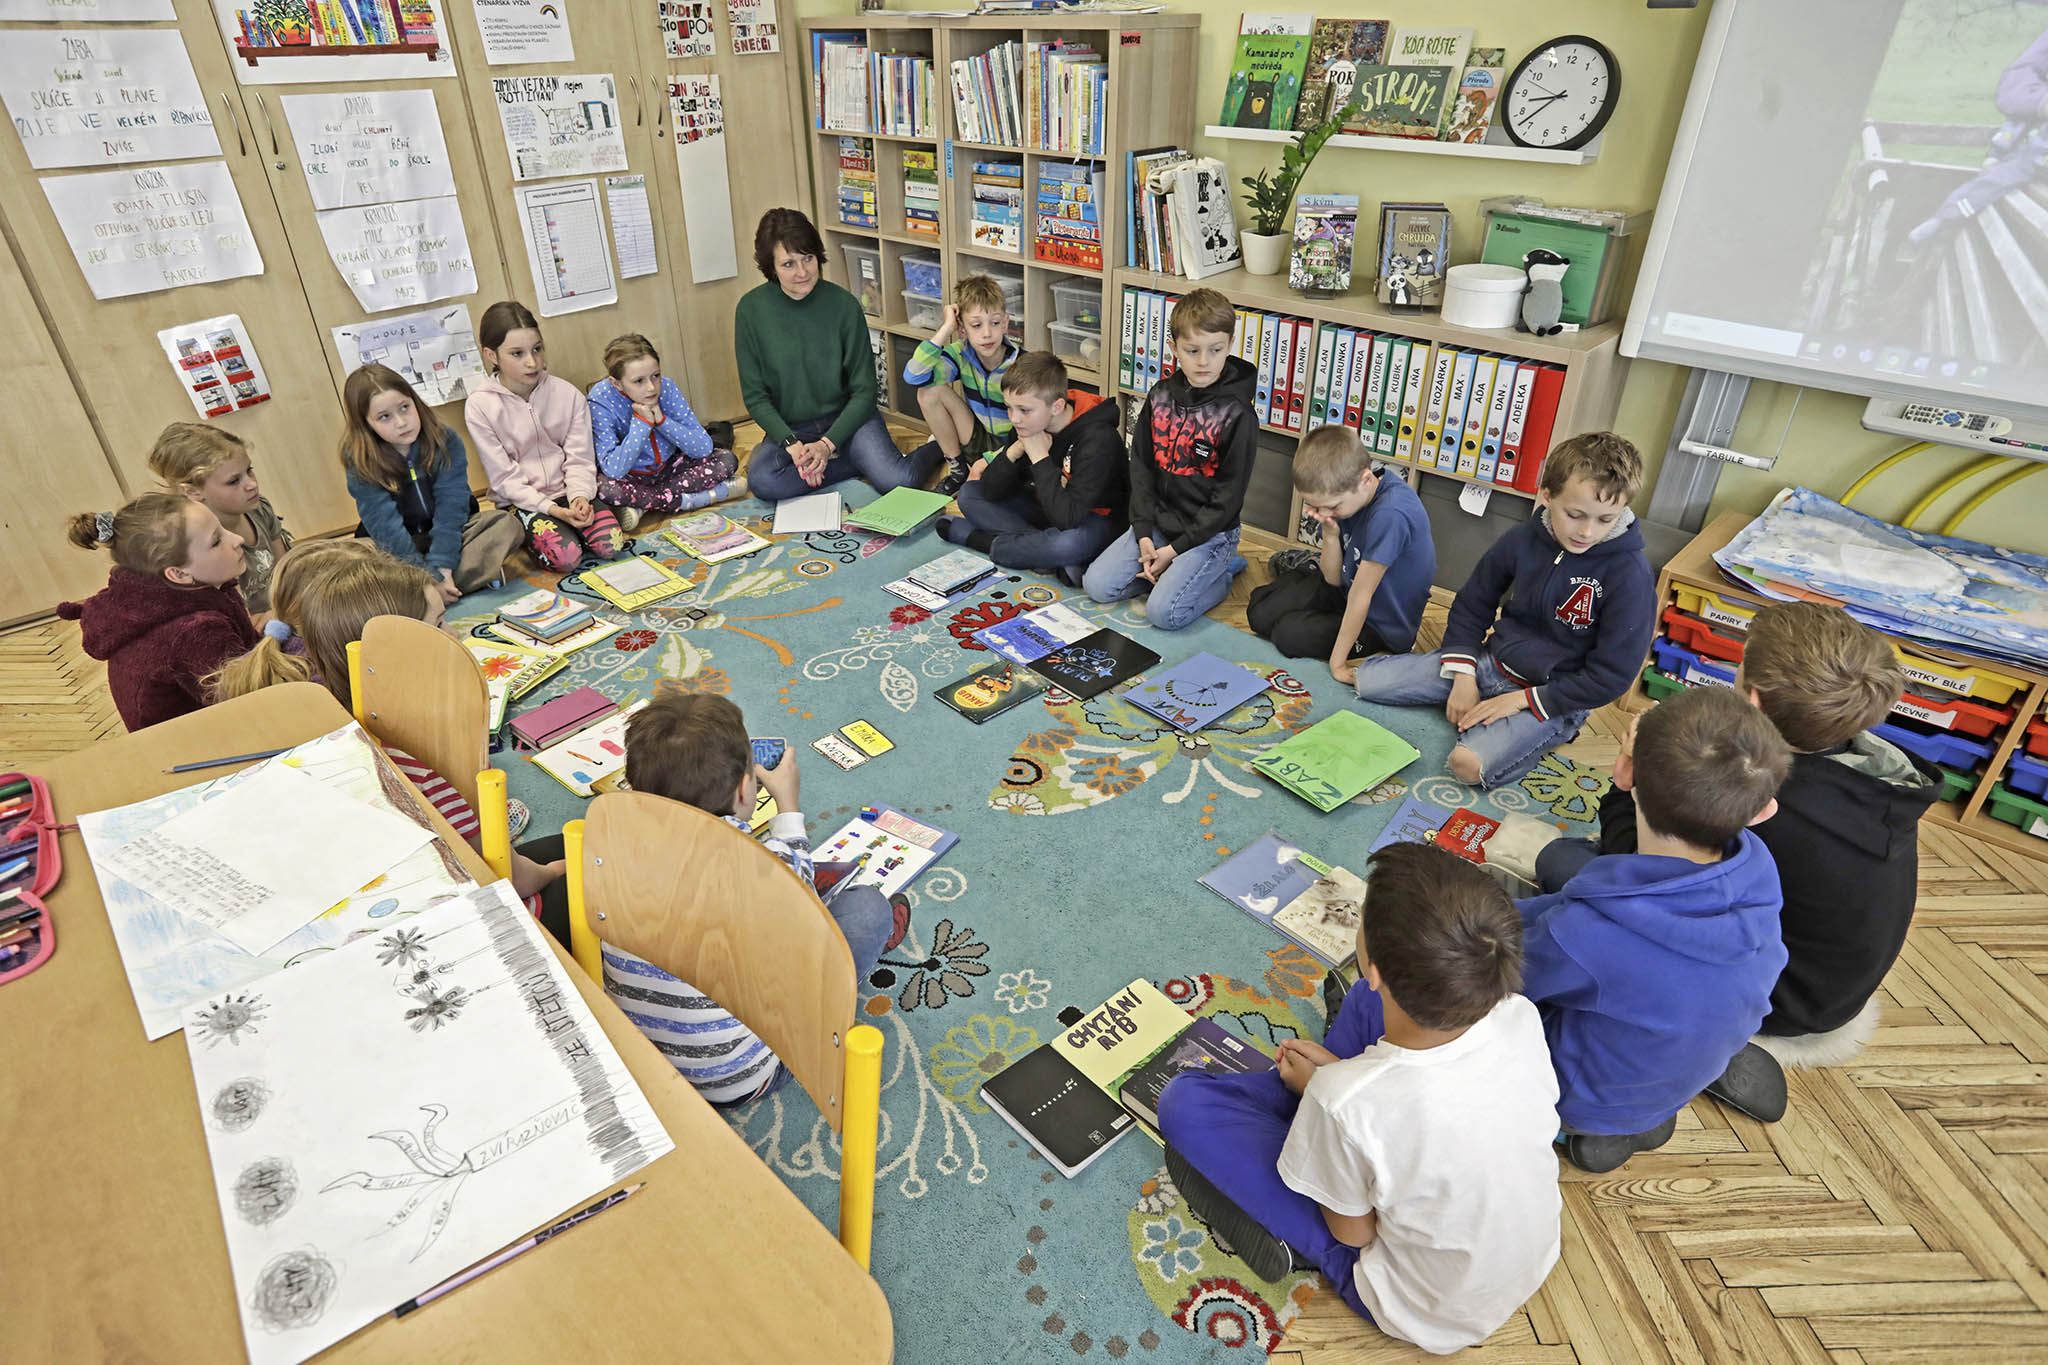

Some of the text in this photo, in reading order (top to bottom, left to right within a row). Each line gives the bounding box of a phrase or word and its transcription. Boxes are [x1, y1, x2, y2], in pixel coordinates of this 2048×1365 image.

[1402, 35, 1425, 55] KDO
[1246, 48, 1294, 60] Kamarád pro
[1567, 56, 1577, 65] 12
[1329, 70, 1356, 86] ROK
[1532, 73, 1542, 81] 10
[1592, 78, 1598, 86] 2
[564, 82, 583, 93] nejen
[1360, 71, 1436, 115] STROM
[1521, 89, 1528, 97] 9
[31, 89, 73, 111] SKÁČE
[121, 89, 158, 104] PLAVE
[499, 92, 524, 103] PROTI
[1590, 96, 1597, 104] 3
[1519, 107, 1525, 115] 8
[79, 113, 101, 129] VE
[117, 114, 157, 128] VELKÉM
[1579, 113, 1585, 121] 4
[1543, 129, 1549, 137] 6
[1561, 126, 1567, 134] 5
[389, 160, 399, 168] DO
[1312, 197, 1334, 208] kým
[1398, 232, 1436, 244] CHRUJDA
[373, 325, 417, 341] HOUSE
[1262, 330, 1272, 368] JANIČKA
[1280, 339, 1288, 364] KUBA
[1320, 349, 1328, 374] ALAN
[1335, 342, 1347, 387] BARUNKA
[1354, 350, 1364, 382] ONDRA
[1371, 352, 1383, 393] DAVÍDEK
[1391, 366, 1401, 393] KUBÍK
[1454, 379, 1465, 400] MAX
[1495, 390, 1506, 411] DAN
[1512, 384, 1527, 424] ADÉLKA
[1273, 412, 1282, 420] 11.
[1291, 416, 1300, 424] 12.
[1362, 435, 1372, 443] 16.
[1381, 439, 1390, 447] 17.
[1400, 444, 1409, 452] 18.
[1423, 449, 1432, 457] 19.
[1440, 454, 1451, 463] 20.
[1706, 450, 1744, 465] TABULE
[1461, 460, 1472, 468] 21.
[1480, 463, 1491, 471] 22.
[1500, 468, 1511, 477] 23.
[1710, 611, 1742, 627] PAPÍRY
[1942, 678, 1968, 693] BÍLÉ
[1066, 986, 1144, 1050] CHYTÁNÍ
[1096, 1016, 1139, 1052] RYB
